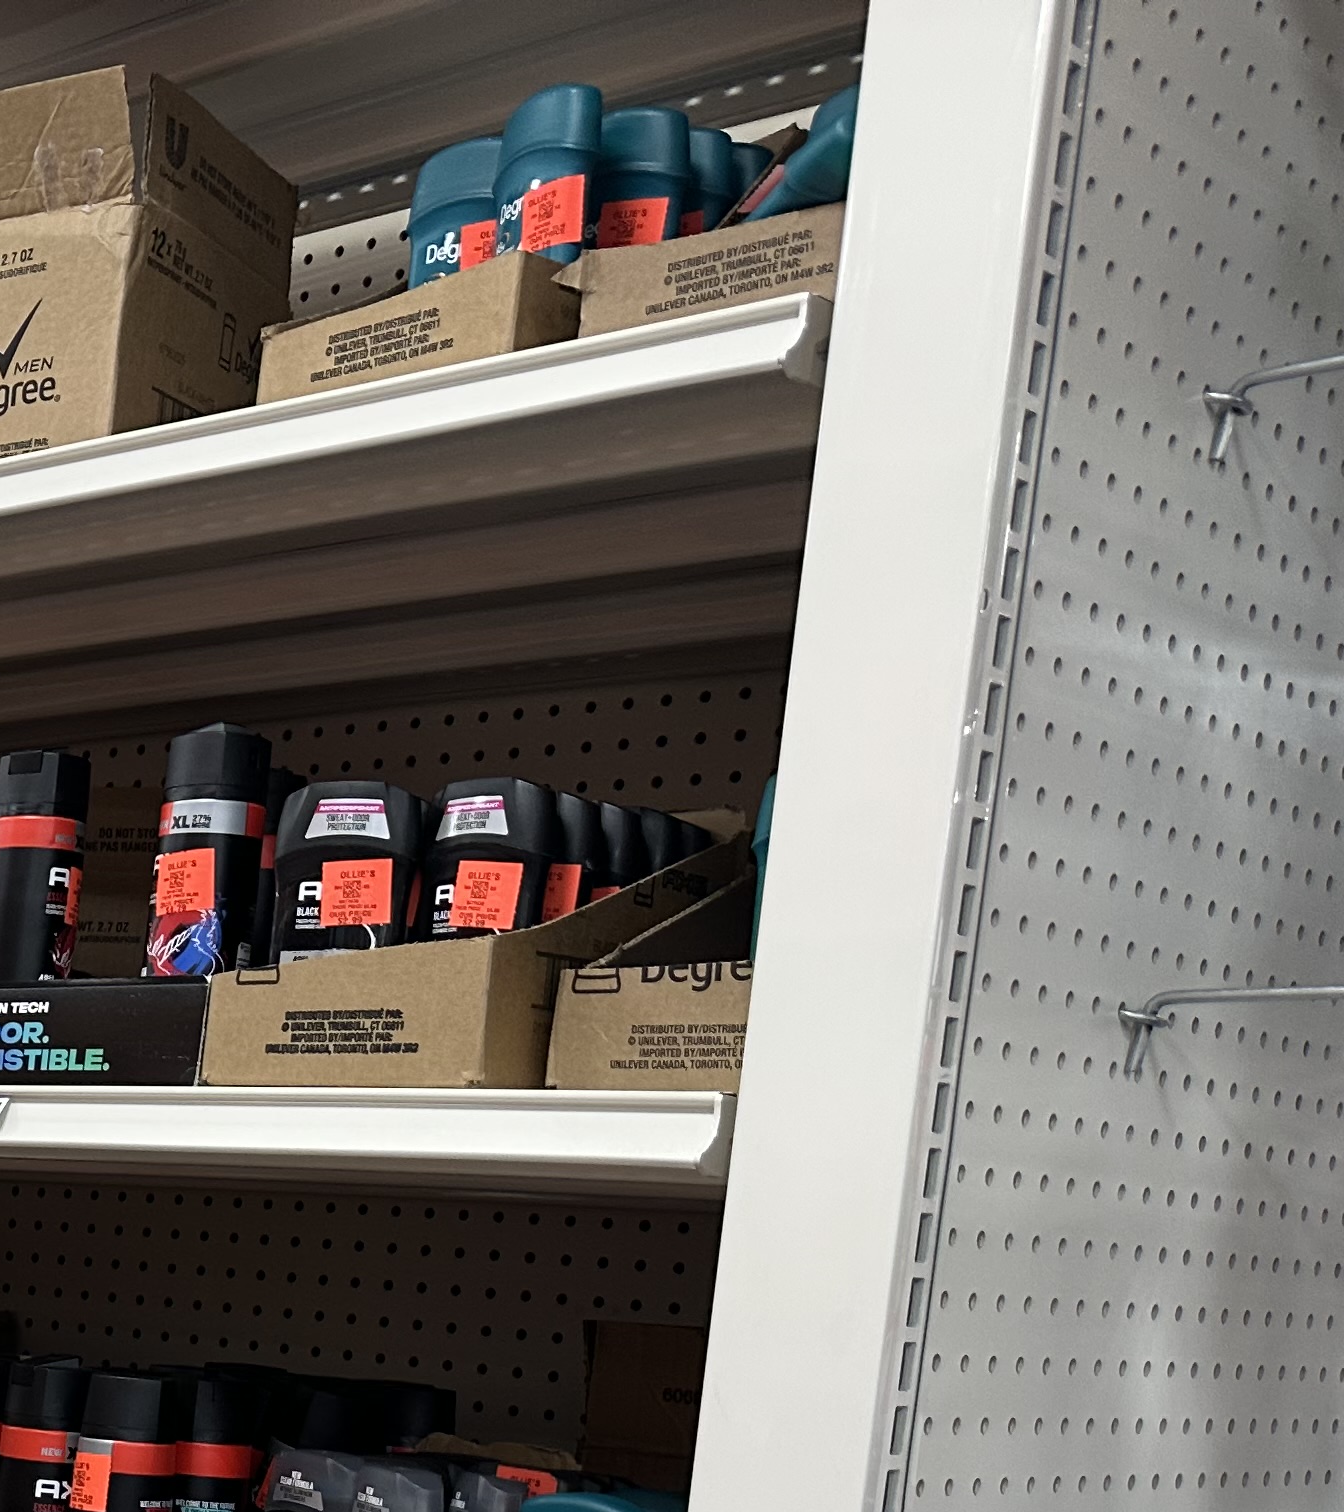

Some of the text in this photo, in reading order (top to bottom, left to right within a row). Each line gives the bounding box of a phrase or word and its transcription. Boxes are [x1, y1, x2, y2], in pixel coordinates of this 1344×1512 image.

[151, 226, 166, 259] 12
[20, 248, 34, 262] OZ
[668, 252, 723, 272] DISTRIBUTED
[674, 265, 718, 283] UNILEVER,
[721, 253, 771, 272] TRUMBULL,
[773, 247, 785, 260] CT
[676, 277, 719, 296] IMPORTED
[645, 296, 686, 316] UNILEVER
[688, 288, 727, 305] CANADA,
[728, 278, 773, 296] TORONTO,
[775, 272, 788, 285] ON
[13, 356, 54, 375] MEN
[171, 815, 189, 829] XL
[116, 828, 135, 838] NOT
[340, 869, 376, 879] OLLIE'S
[468, 872, 501, 881] OLLIE'S
[10, 1001, 50, 1014] TECH
[631, 1024, 685, 1034] DISTRIBUTED
[638, 1036, 680, 1047] UNILEVER,
[682, 1036, 732, 1047] TRUMBULL,
[733, 1036, 745, 1046] CT
[639, 1047, 681, 1058] IMPORTED
[610, 1059, 733, 1071] UNILEVER CANADA, TORONTO,
